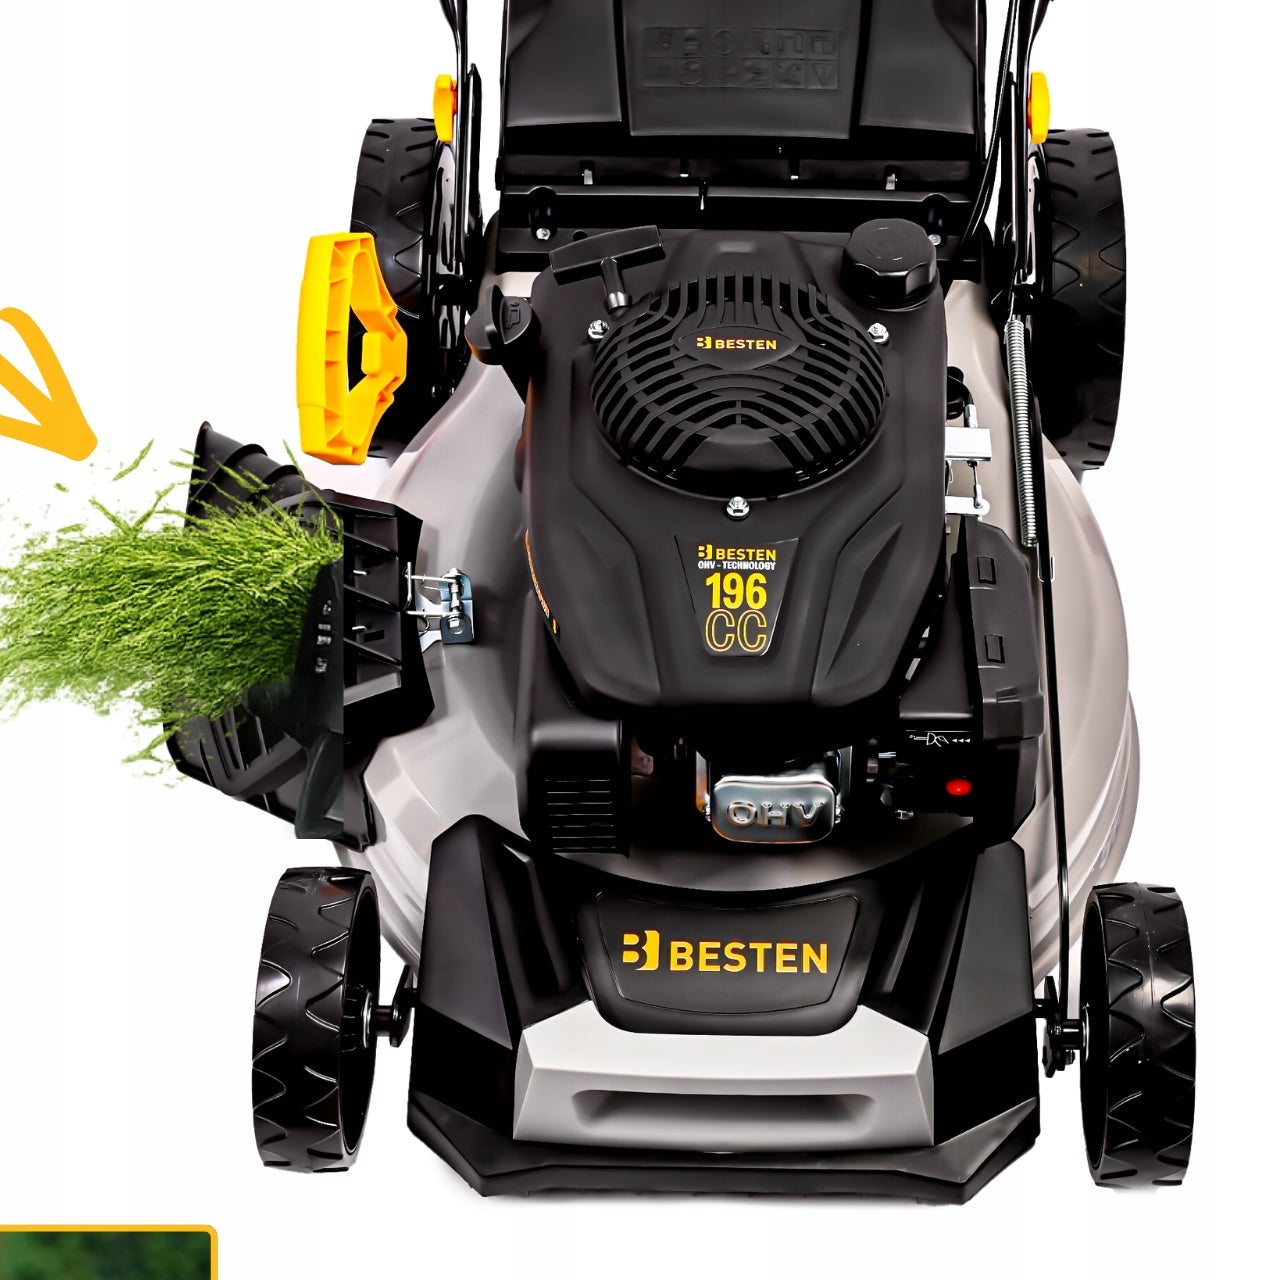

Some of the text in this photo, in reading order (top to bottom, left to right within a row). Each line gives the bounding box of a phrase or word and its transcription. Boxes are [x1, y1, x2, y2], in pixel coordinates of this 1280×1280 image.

[715, 339, 777, 350] BESTEN
[698, 560, 715, 570] OHV
[722, 561, 776, 571] TECHNOLOGY
[716, 548, 777, 561] BESTEN
[705, 572, 767, 609] 196
[705, 609, 767, 652] CC
[727, 800, 825, 828] OHV
[670, 941, 828, 974] BESTEN
